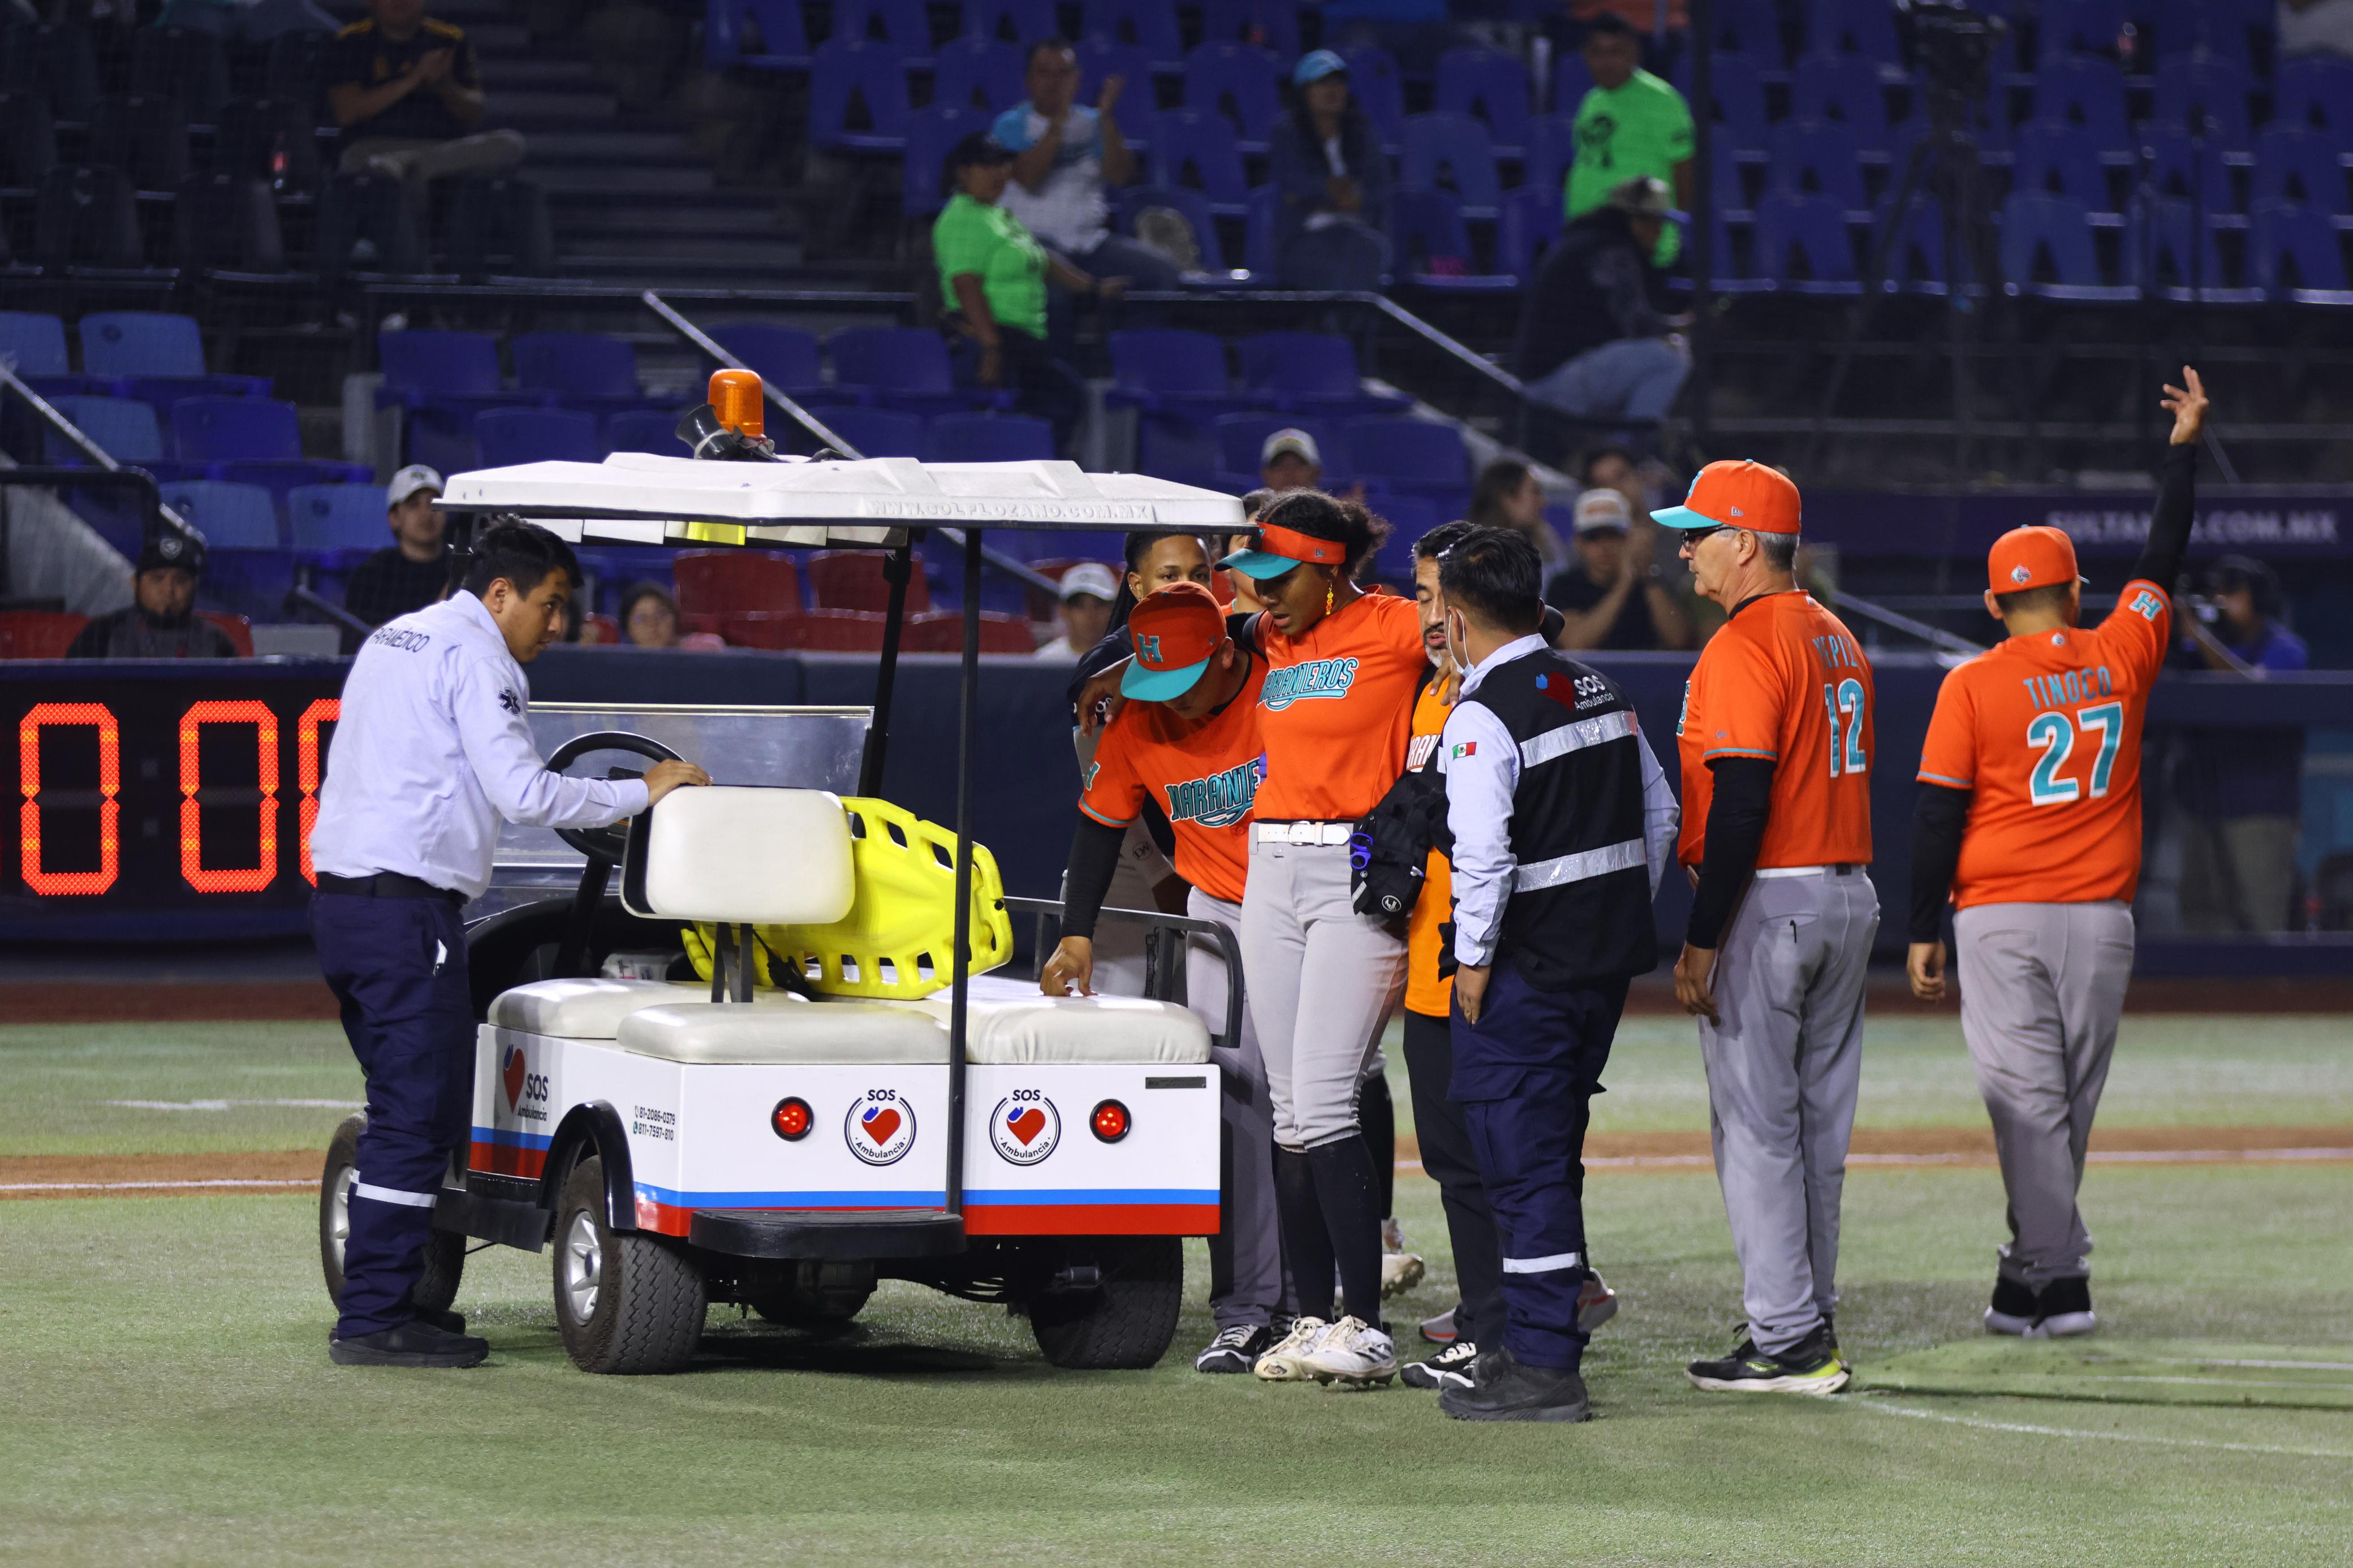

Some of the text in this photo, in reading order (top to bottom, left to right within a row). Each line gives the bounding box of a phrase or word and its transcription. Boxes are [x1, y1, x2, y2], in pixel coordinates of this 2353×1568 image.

[2128, 590, 2164, 622] H
[1137, 633, 1163, 663] H
[1574, 675, 1606, 696] SOS
[2023, 666, 2111, 709] TINOCO
[1574, 692, 1615, 710] Ambulancia
[1824, 678, 1866, 778] 12
[2027, 701, 2124, 807] 27
[526, 1073, 549, 1102] SOS
[867, 1089, 895, 1101] SOS
[1012, 1089, 1041, 1101] SOS
[518, 1104, 547, 1121] Ambulancia
[639, 1107, 675, 1125] 81-2086-0379
[638, 1123, 674, 1141] 811-7597-810
[856, 1142, 905, 1158] Ambulancia
[1001, 1142, 1050, 1158] Ambulancia
